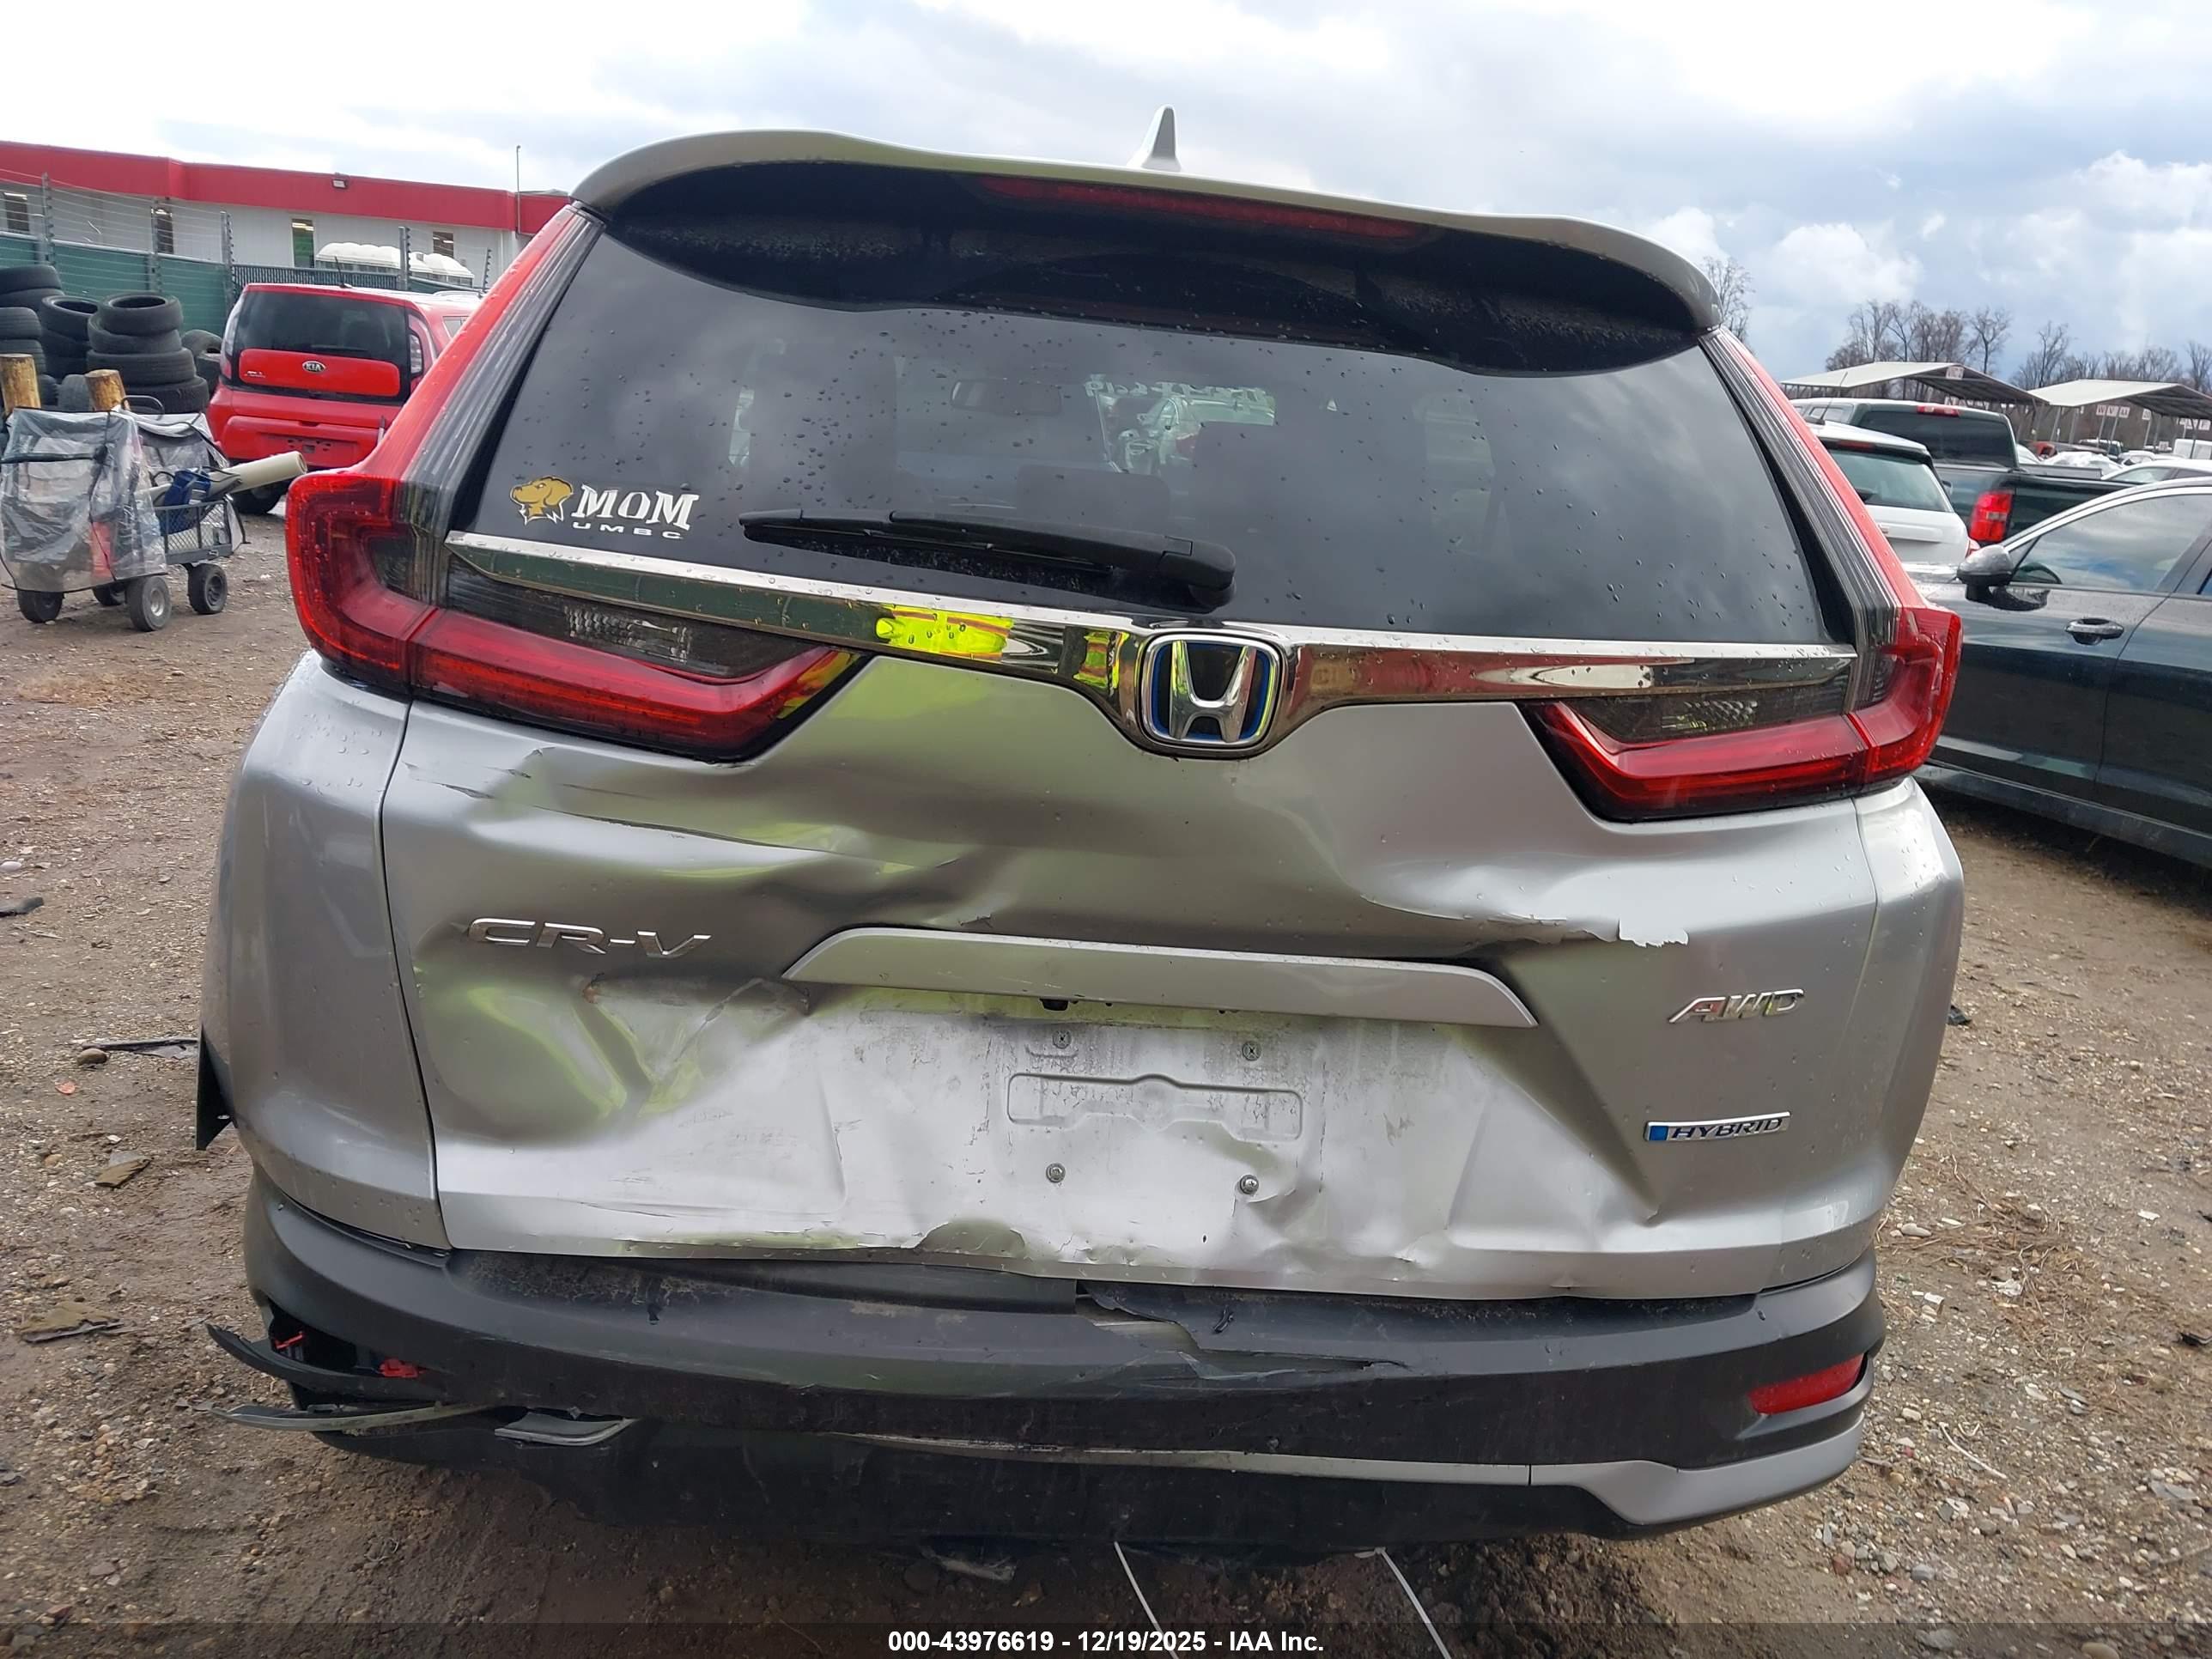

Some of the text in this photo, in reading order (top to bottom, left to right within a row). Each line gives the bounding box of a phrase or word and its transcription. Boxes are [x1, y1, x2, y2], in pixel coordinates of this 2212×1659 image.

[571, 483, 700, 531] MOM
[573, 521, 685, 539] UMBC
[468, 917, 712, 958] CR-V
[1668, 988, 1805, 1023] AWD
[1671, 1117, 1784, 1139] HYBRID
